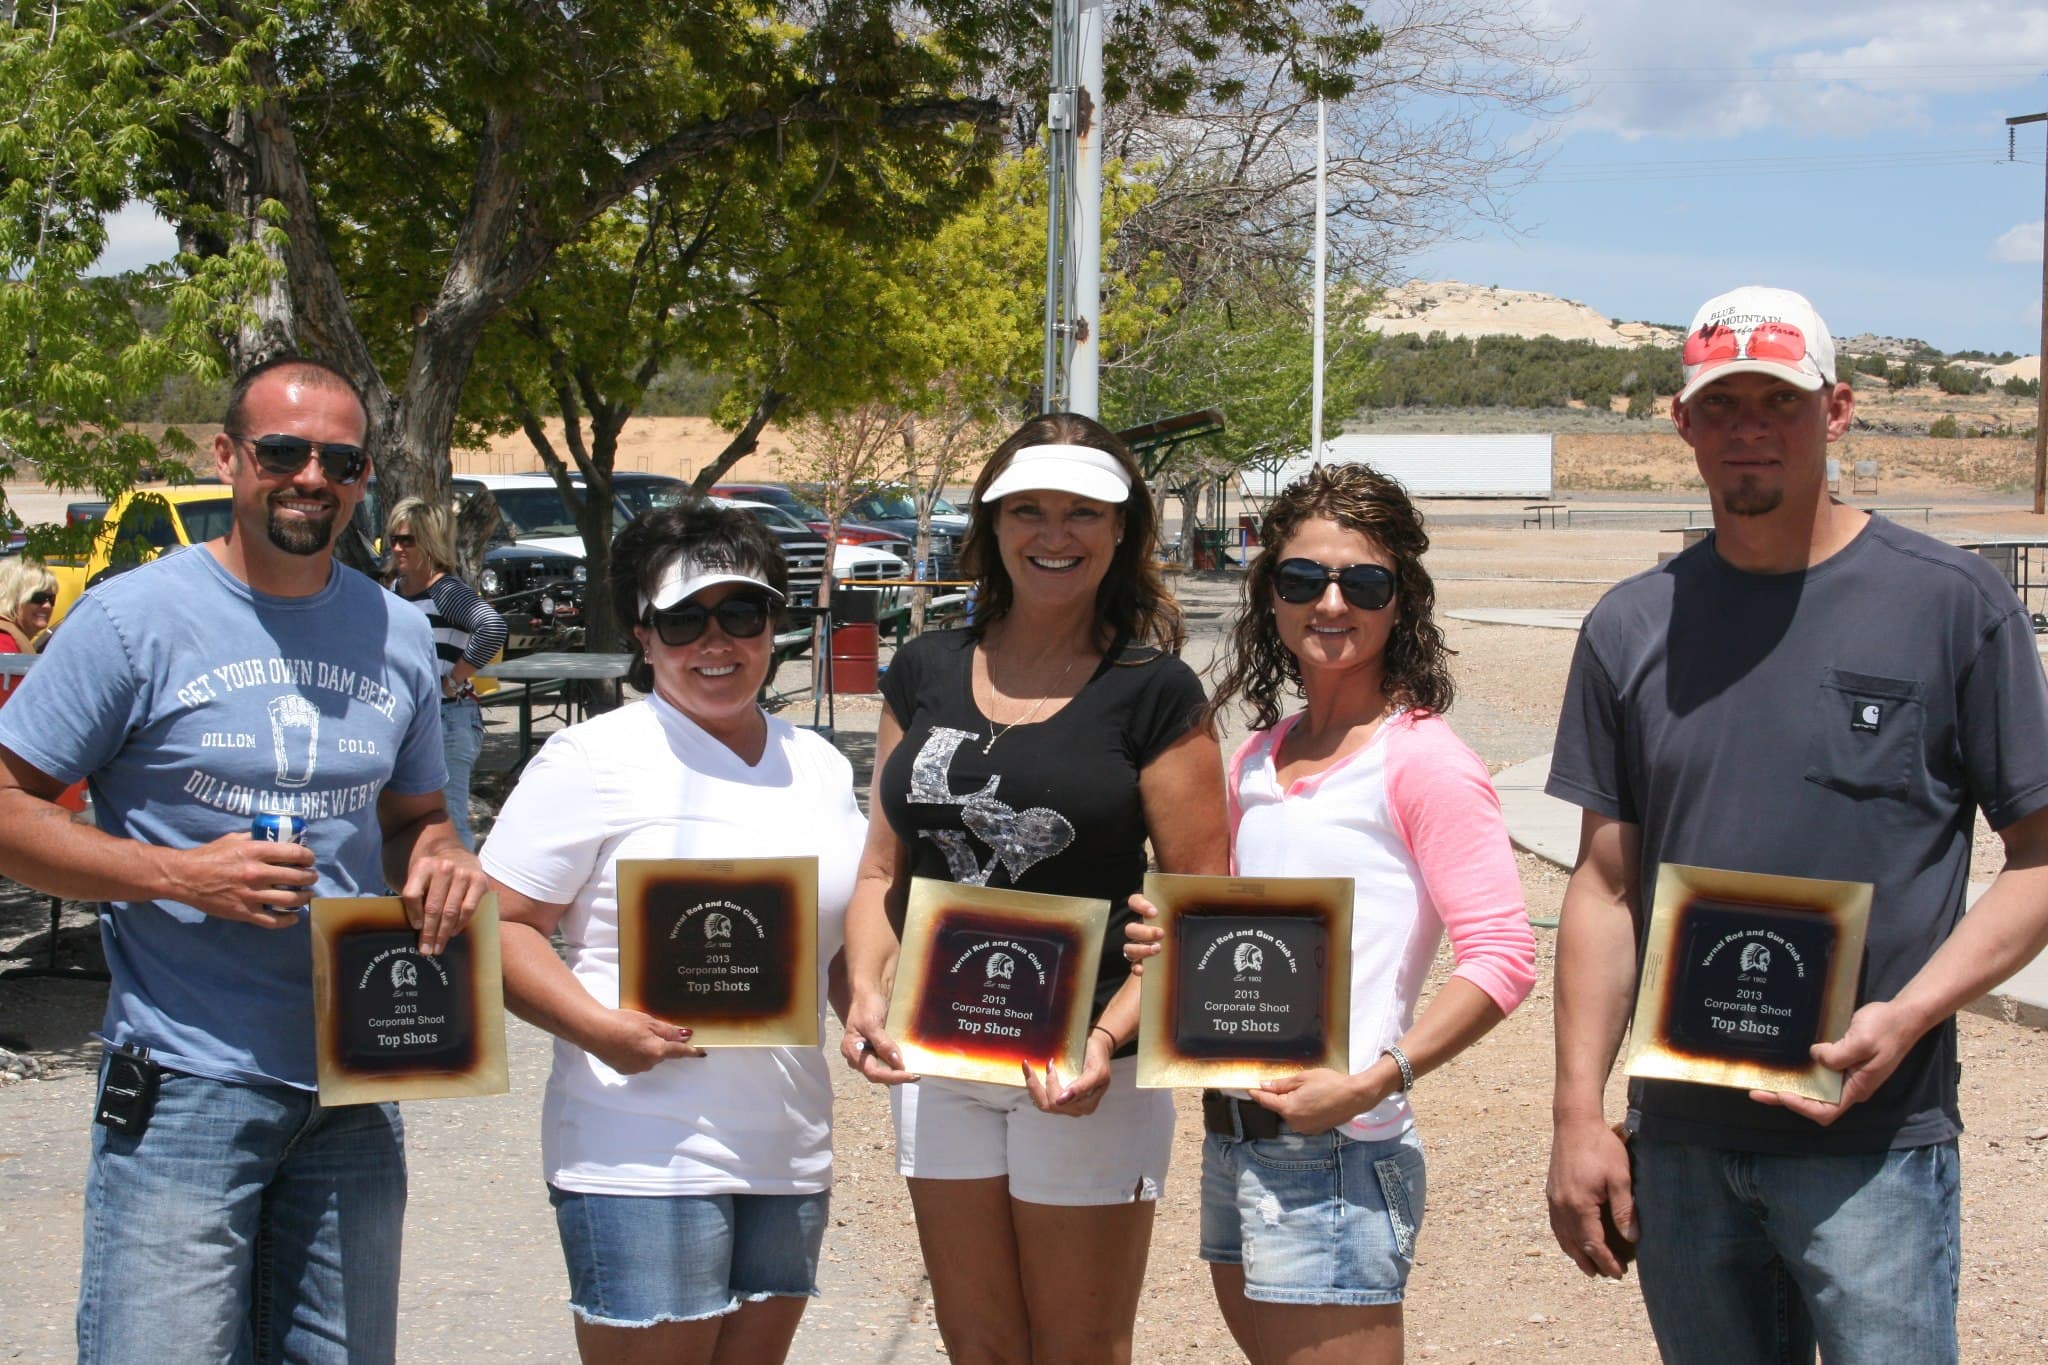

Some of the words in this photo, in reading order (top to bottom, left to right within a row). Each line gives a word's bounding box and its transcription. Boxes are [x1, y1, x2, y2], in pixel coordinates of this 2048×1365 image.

[1710, 306, 1736, 320] BLUE
[1722, 314, 1782, 325] MOUNTAIN
[177, 674, 217, 709] GET
[213, 658, 267, 692] YOUR
[269, 658, 312, 686] OWN
[317, 662, 355, 696] DAM
[201, 733, 256, 749] DILLON
[338, 738, 380, 755] COLO.
[183, 769, 254, 816] DILLON
[259, 790, 296, 811] DAM
[302, 778, 381, 820] BREWERY
[669, 914, 688, 939] Vernal
[686, 904, 703, 916] Rod
[705, 900, 722, 908] and
[724, 901, 741, 912] Gun
[742, 908, 758, 925] Club
[756, 925, 765, 939] Inc
[706, 955, 730, 963] 2013
[950, 949, 972, 973] Vernal
[972, 941, 989, 953] Rod
[1011, 942, 1028, 955] Gun
[1028, 952, 1042, 970] Club
[1197, 943, 1217, 970] Vernal
[1216, 932, 1234, 944] Rod
[1256, 930, 1274, 942] Gun
[1275, 940, 1291, 958] Club
[1289, 958, 1297, 974] Inc
[1702, 940, 1725, 966] Vernal
[1725, 930, 1743, 943] Rod
[1767, 931, 1785, 944] Gun
[1785, 942, 1800, 961] Club
[1796, 962, 1804, 978] Inc
[358, 963, 375, 989] Vernal
[374, 950, 389, 963] Rod
[391, 946, 406, 954] and
[440, 971, 449, 986] Inc
[678, 966, 727, 976] Corporate
[730, 965, 759, 974] Shoot
[687, 981, 710, 994] Top
[713, 980, 750, 991] Shots
[1234, 990, 1260, 999] 2013
[1736, 989, 1762, 1000] 2013
[982, 994, 1006, 1005] 2013
[1204, 1001, 1256, 1012] Corporate
[1260, 1003, 1290, 1013] Shoot
[394, 1004, 417, 1014] 2013
[951, 1001, 1001, 1016] Corporate
[1004, 1008, 1033, 1020] Shoot
[1704, 998, 1757, 1013] Corporate
[1760, 1004, 1792, 1017] Shoot
[368, 1017, 415, 1028] Corporate
[418, 1015, 444, 1025] Shoot
[957, 1018, 981, 1034] Top
[984, 1022, 1021, 1037] Shots
[1213, 1019, 1237, 1034] Top
[1241, 1019, 1280, 1032] Shots
[1711, 1016, 1736, 1033] Top
[1739, 1019, 1780, 1036] Shots
[378, 1034, 400, 1047] Top
[403, 1032, 438, 1045] Shots
